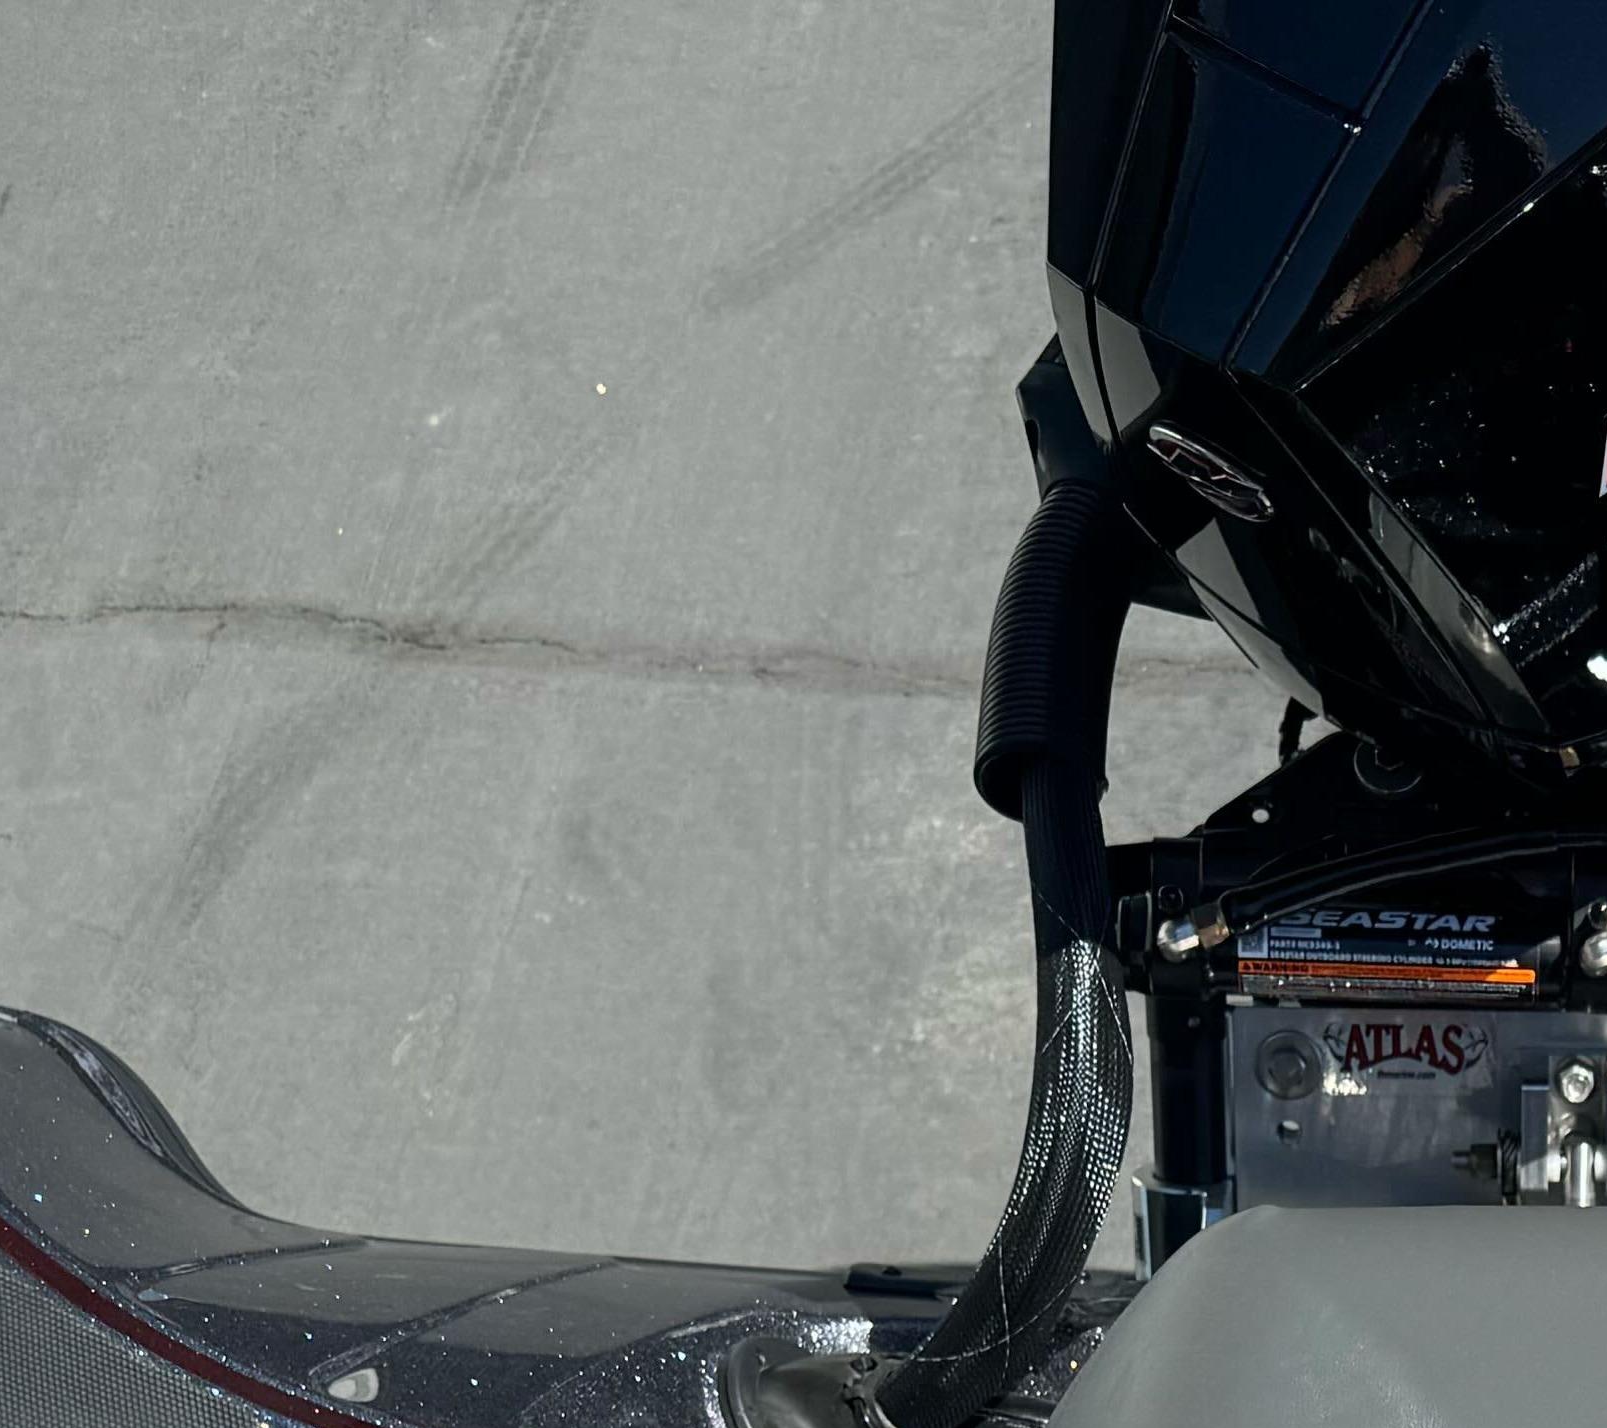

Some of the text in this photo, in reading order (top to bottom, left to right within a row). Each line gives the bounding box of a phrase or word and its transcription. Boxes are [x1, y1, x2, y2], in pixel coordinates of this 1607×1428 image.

[1279, 909, 1496, 933] SEASTAR
[1441, 938, 1494, 952] DOMETIC
[1341, 1022, 1466, 1076] ATLAS
